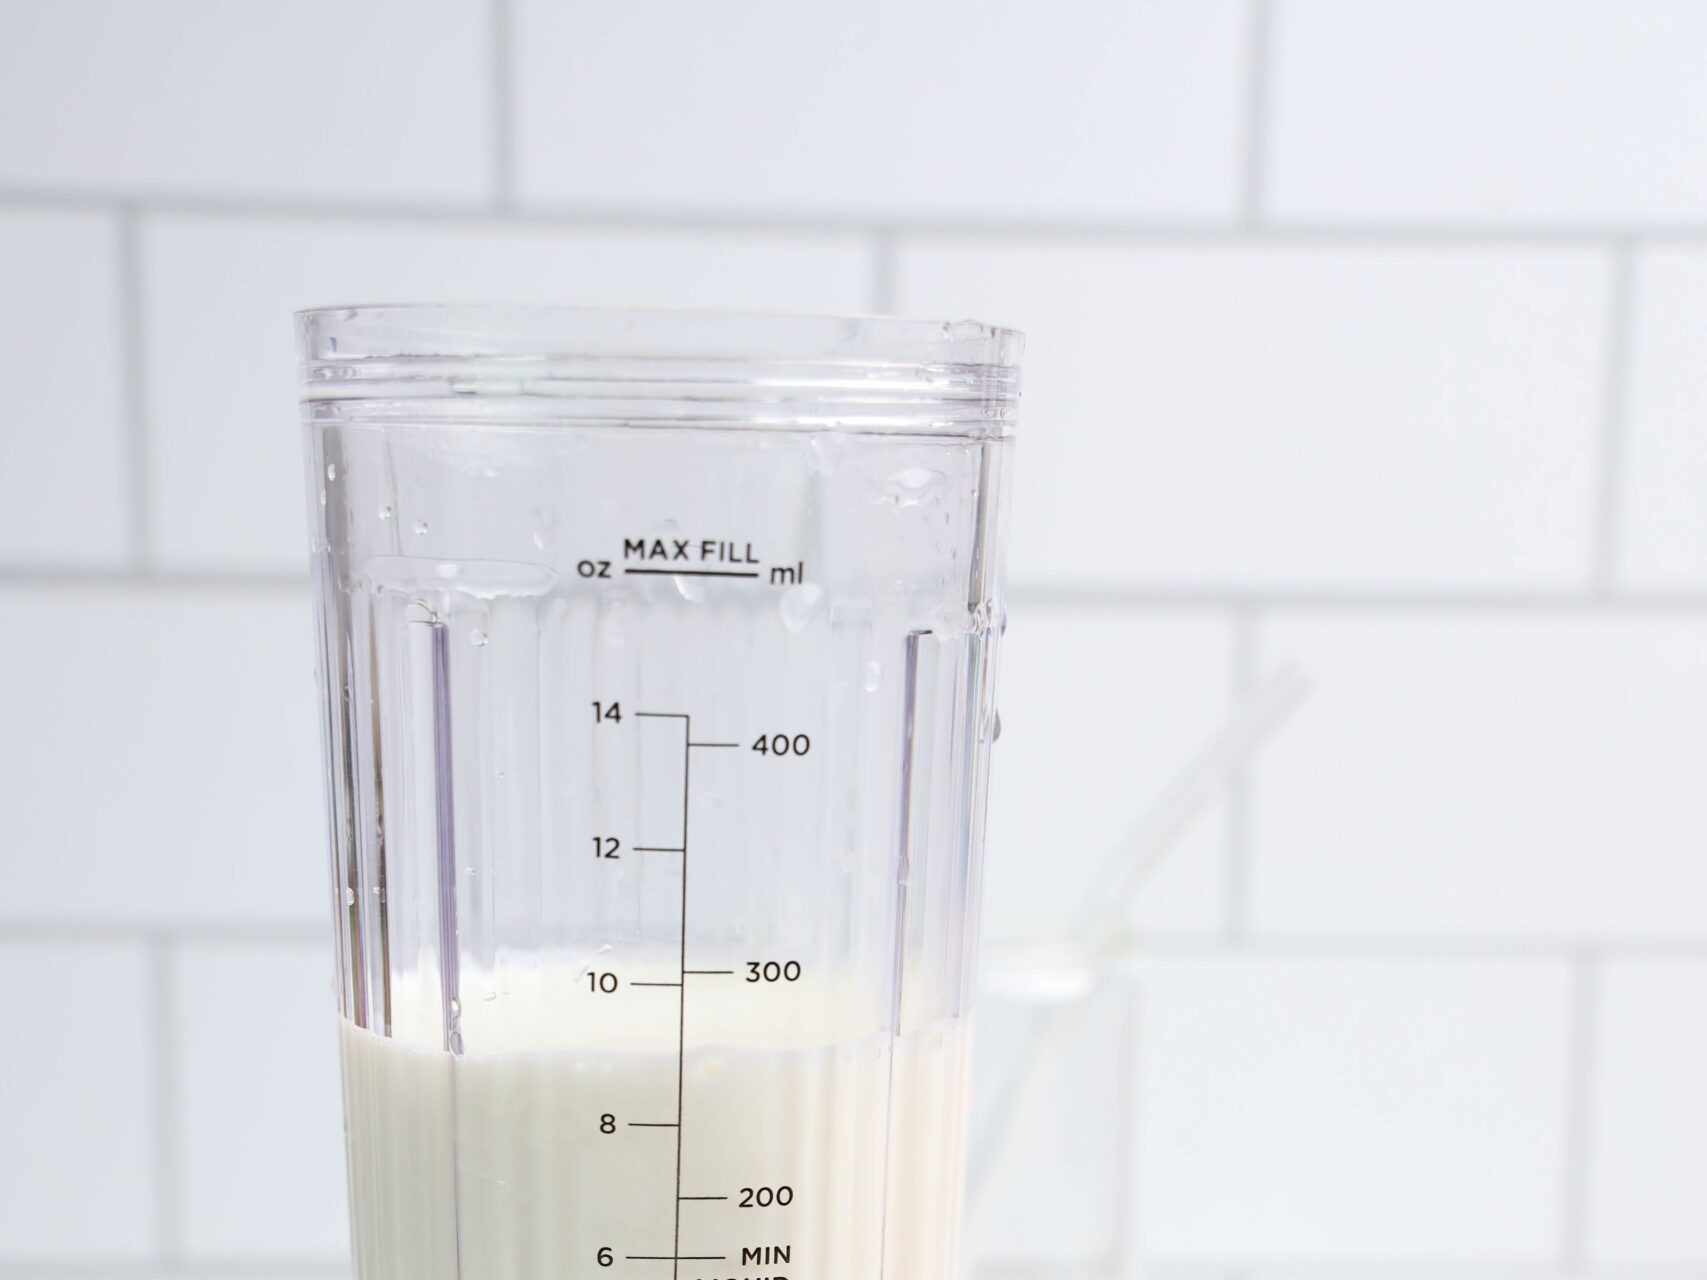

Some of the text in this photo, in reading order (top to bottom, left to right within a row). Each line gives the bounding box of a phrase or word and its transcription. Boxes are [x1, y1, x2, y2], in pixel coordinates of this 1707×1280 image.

[624, 538, 759, 564] MAX FILL
[577, 560, 612, 579] oz
[770, 561, 803, 584] ml
[592, 701, 622, 724] 14
[751, 733, 810, 756] 400
[592, 836, 620, 859] 12
[587, 971, 618, 994] 10
[745, 960, 801, 983] 300
[599, 1113, 616, 1135] 8
[738, 1185, 794, 1208] 200
[597, 1246, 614, 1268] 6
[741, 1245, 791, 1266] MIN
